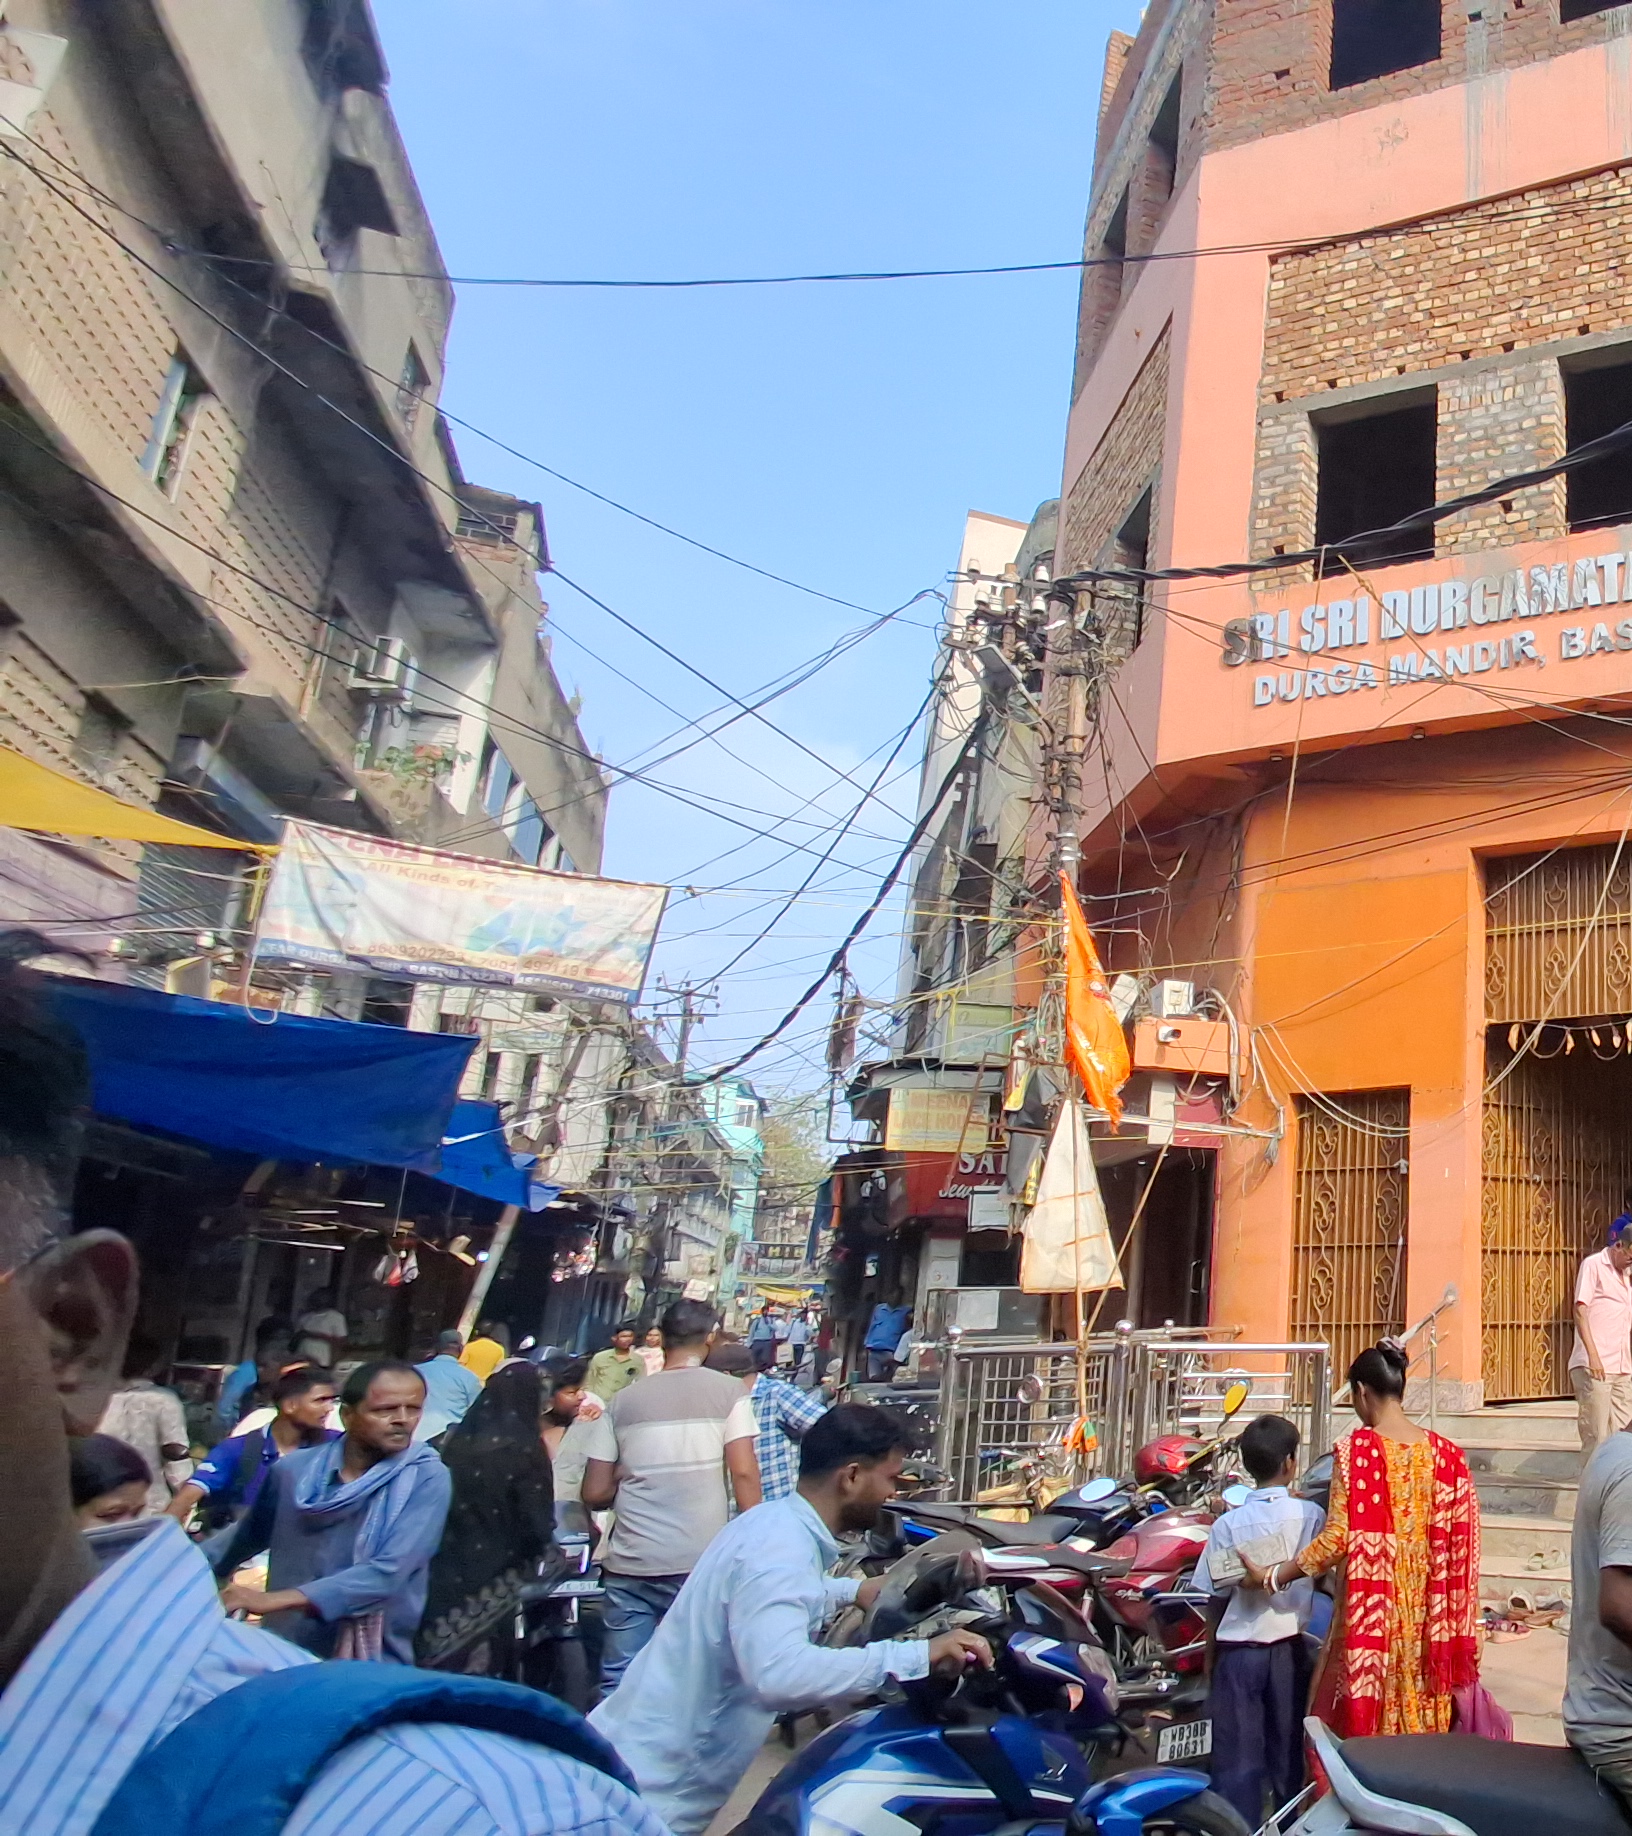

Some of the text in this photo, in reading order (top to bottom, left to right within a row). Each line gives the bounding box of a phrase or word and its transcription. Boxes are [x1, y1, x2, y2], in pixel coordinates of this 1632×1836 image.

[1223, 609, 1290, 666] SRI
[1299, 597, 1370, 654] SRI
[1254, 660, 1377, 706] DURGA
[1389, 630, 1545, 686] MANDIR,
[397, 866, 449, 884] Kinds
